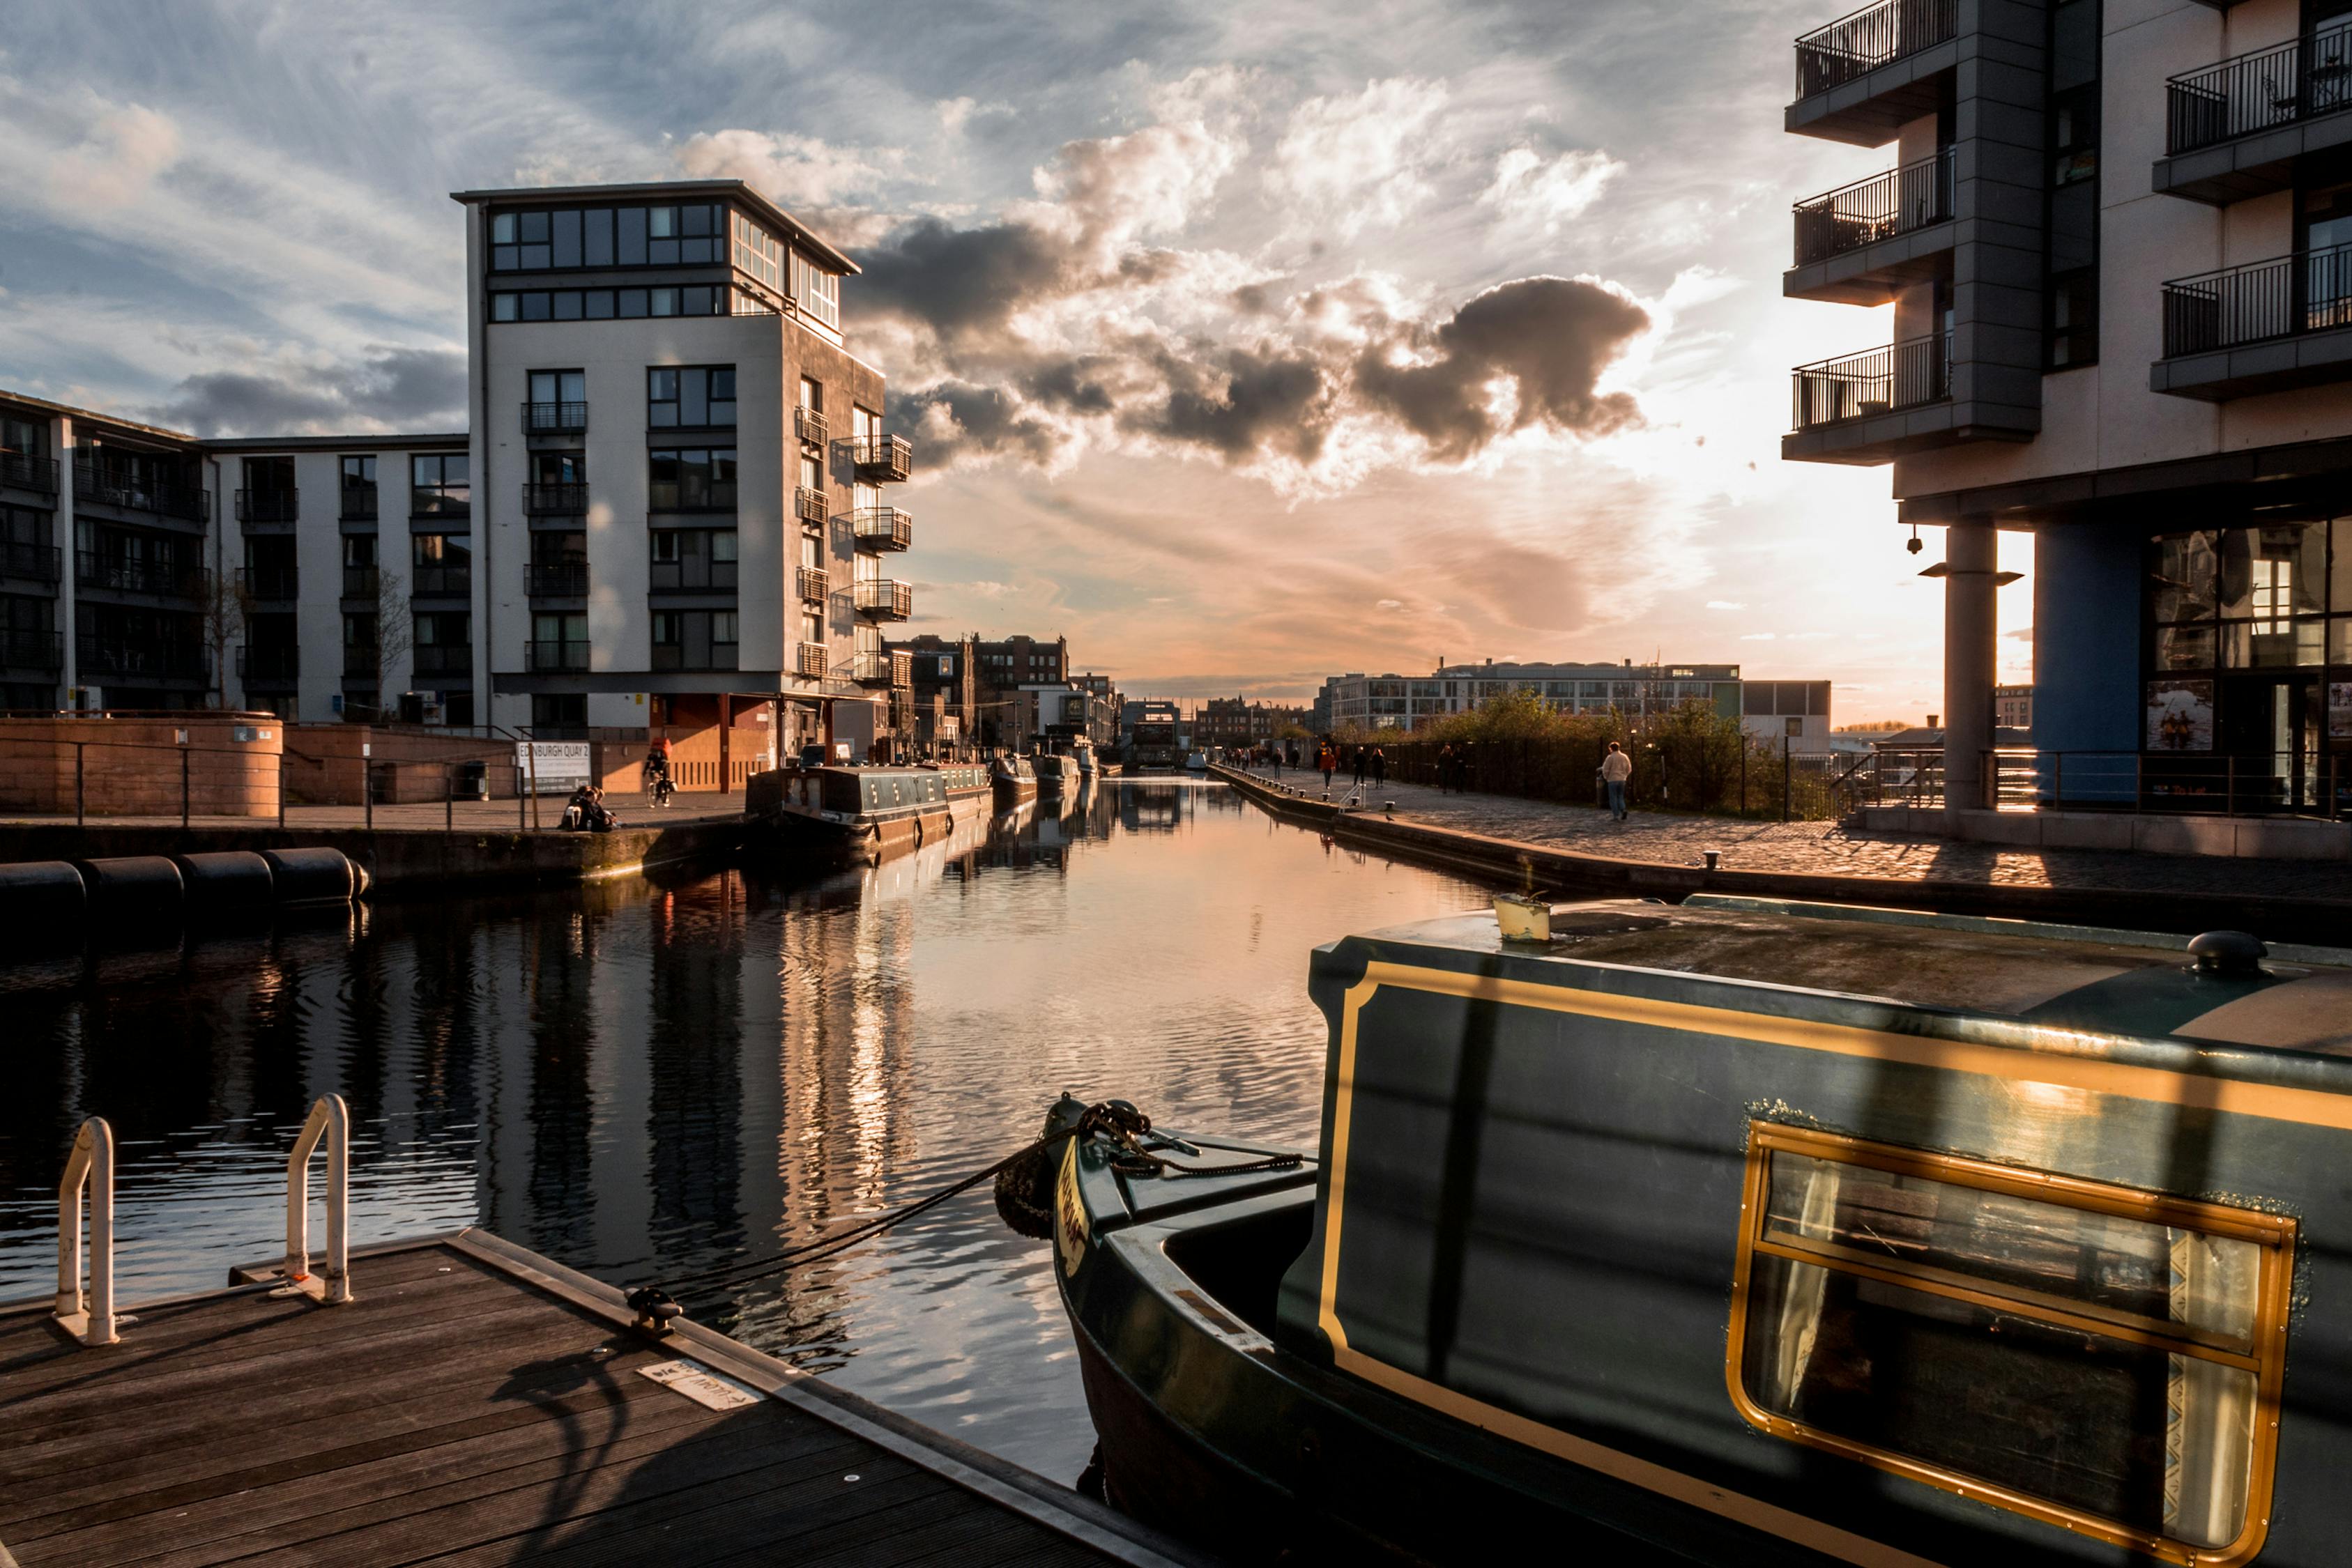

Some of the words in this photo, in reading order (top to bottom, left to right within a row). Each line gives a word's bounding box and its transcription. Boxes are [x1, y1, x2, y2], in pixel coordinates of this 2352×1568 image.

[520, 746, 563, 757] EDNBURGH
[565, 746, 582, 758] QUAY
[584, 746, 588, 756] 2
